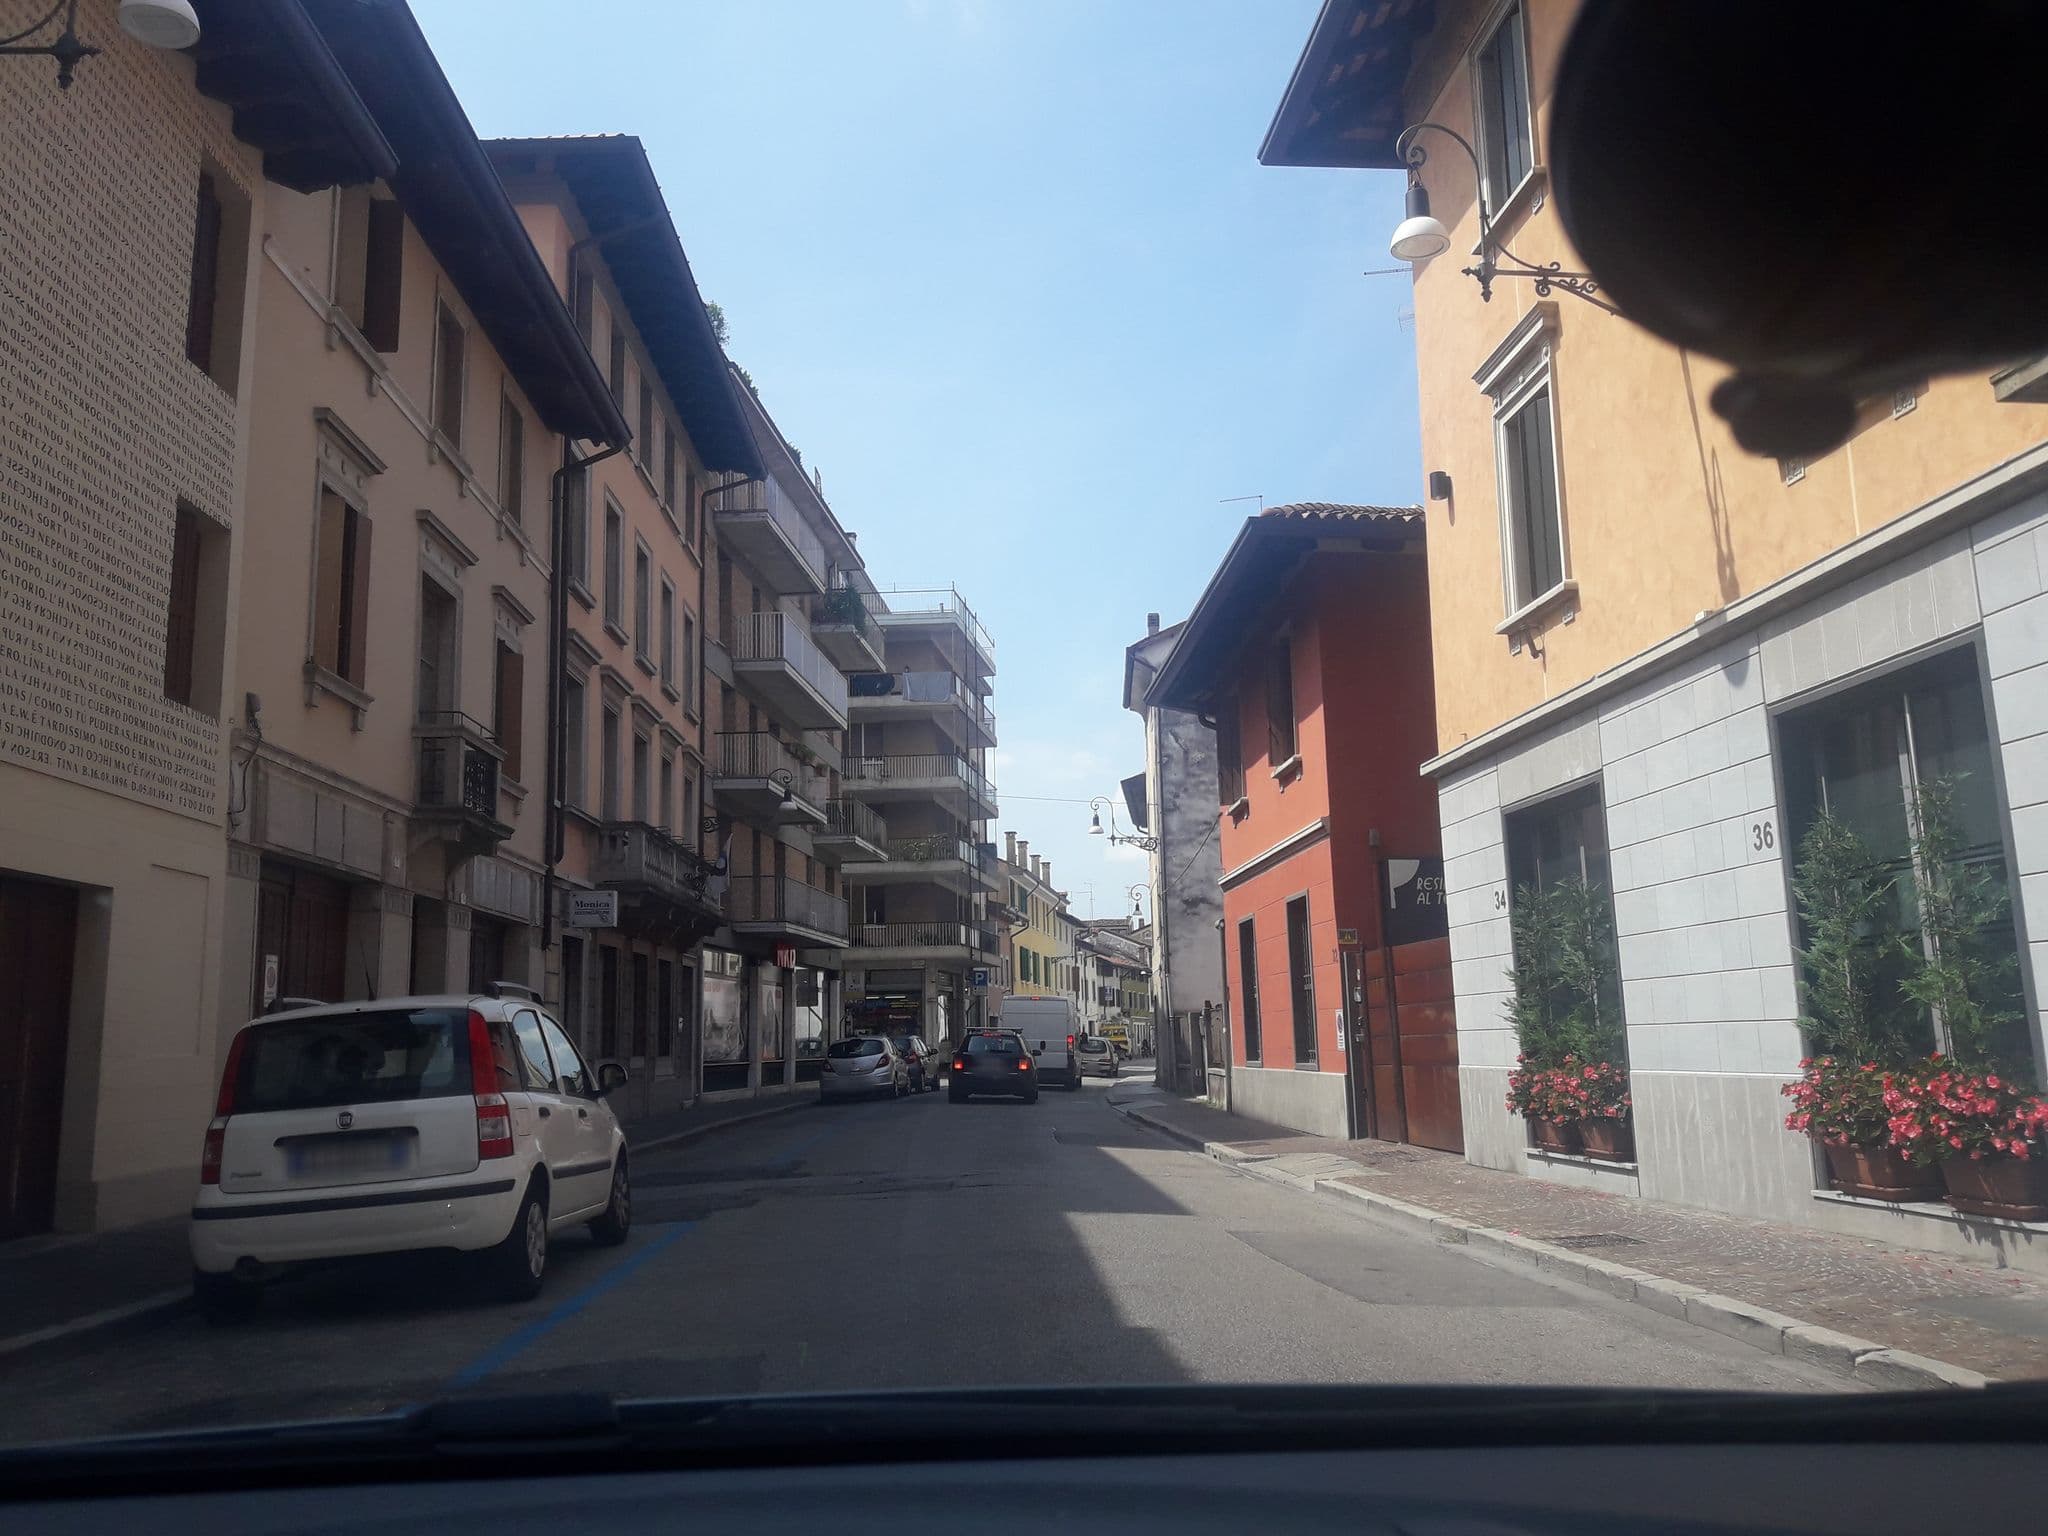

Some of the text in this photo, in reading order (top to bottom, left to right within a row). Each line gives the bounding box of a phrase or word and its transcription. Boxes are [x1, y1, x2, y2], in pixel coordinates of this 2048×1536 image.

[1752, 821, 1775, 851] 36
[575, 900, 611, 909] Monica
[1416, 892, 1446, 905] AL T
[1494, 890, 1507, 910] 34
[975, 972, 985, 985] P
